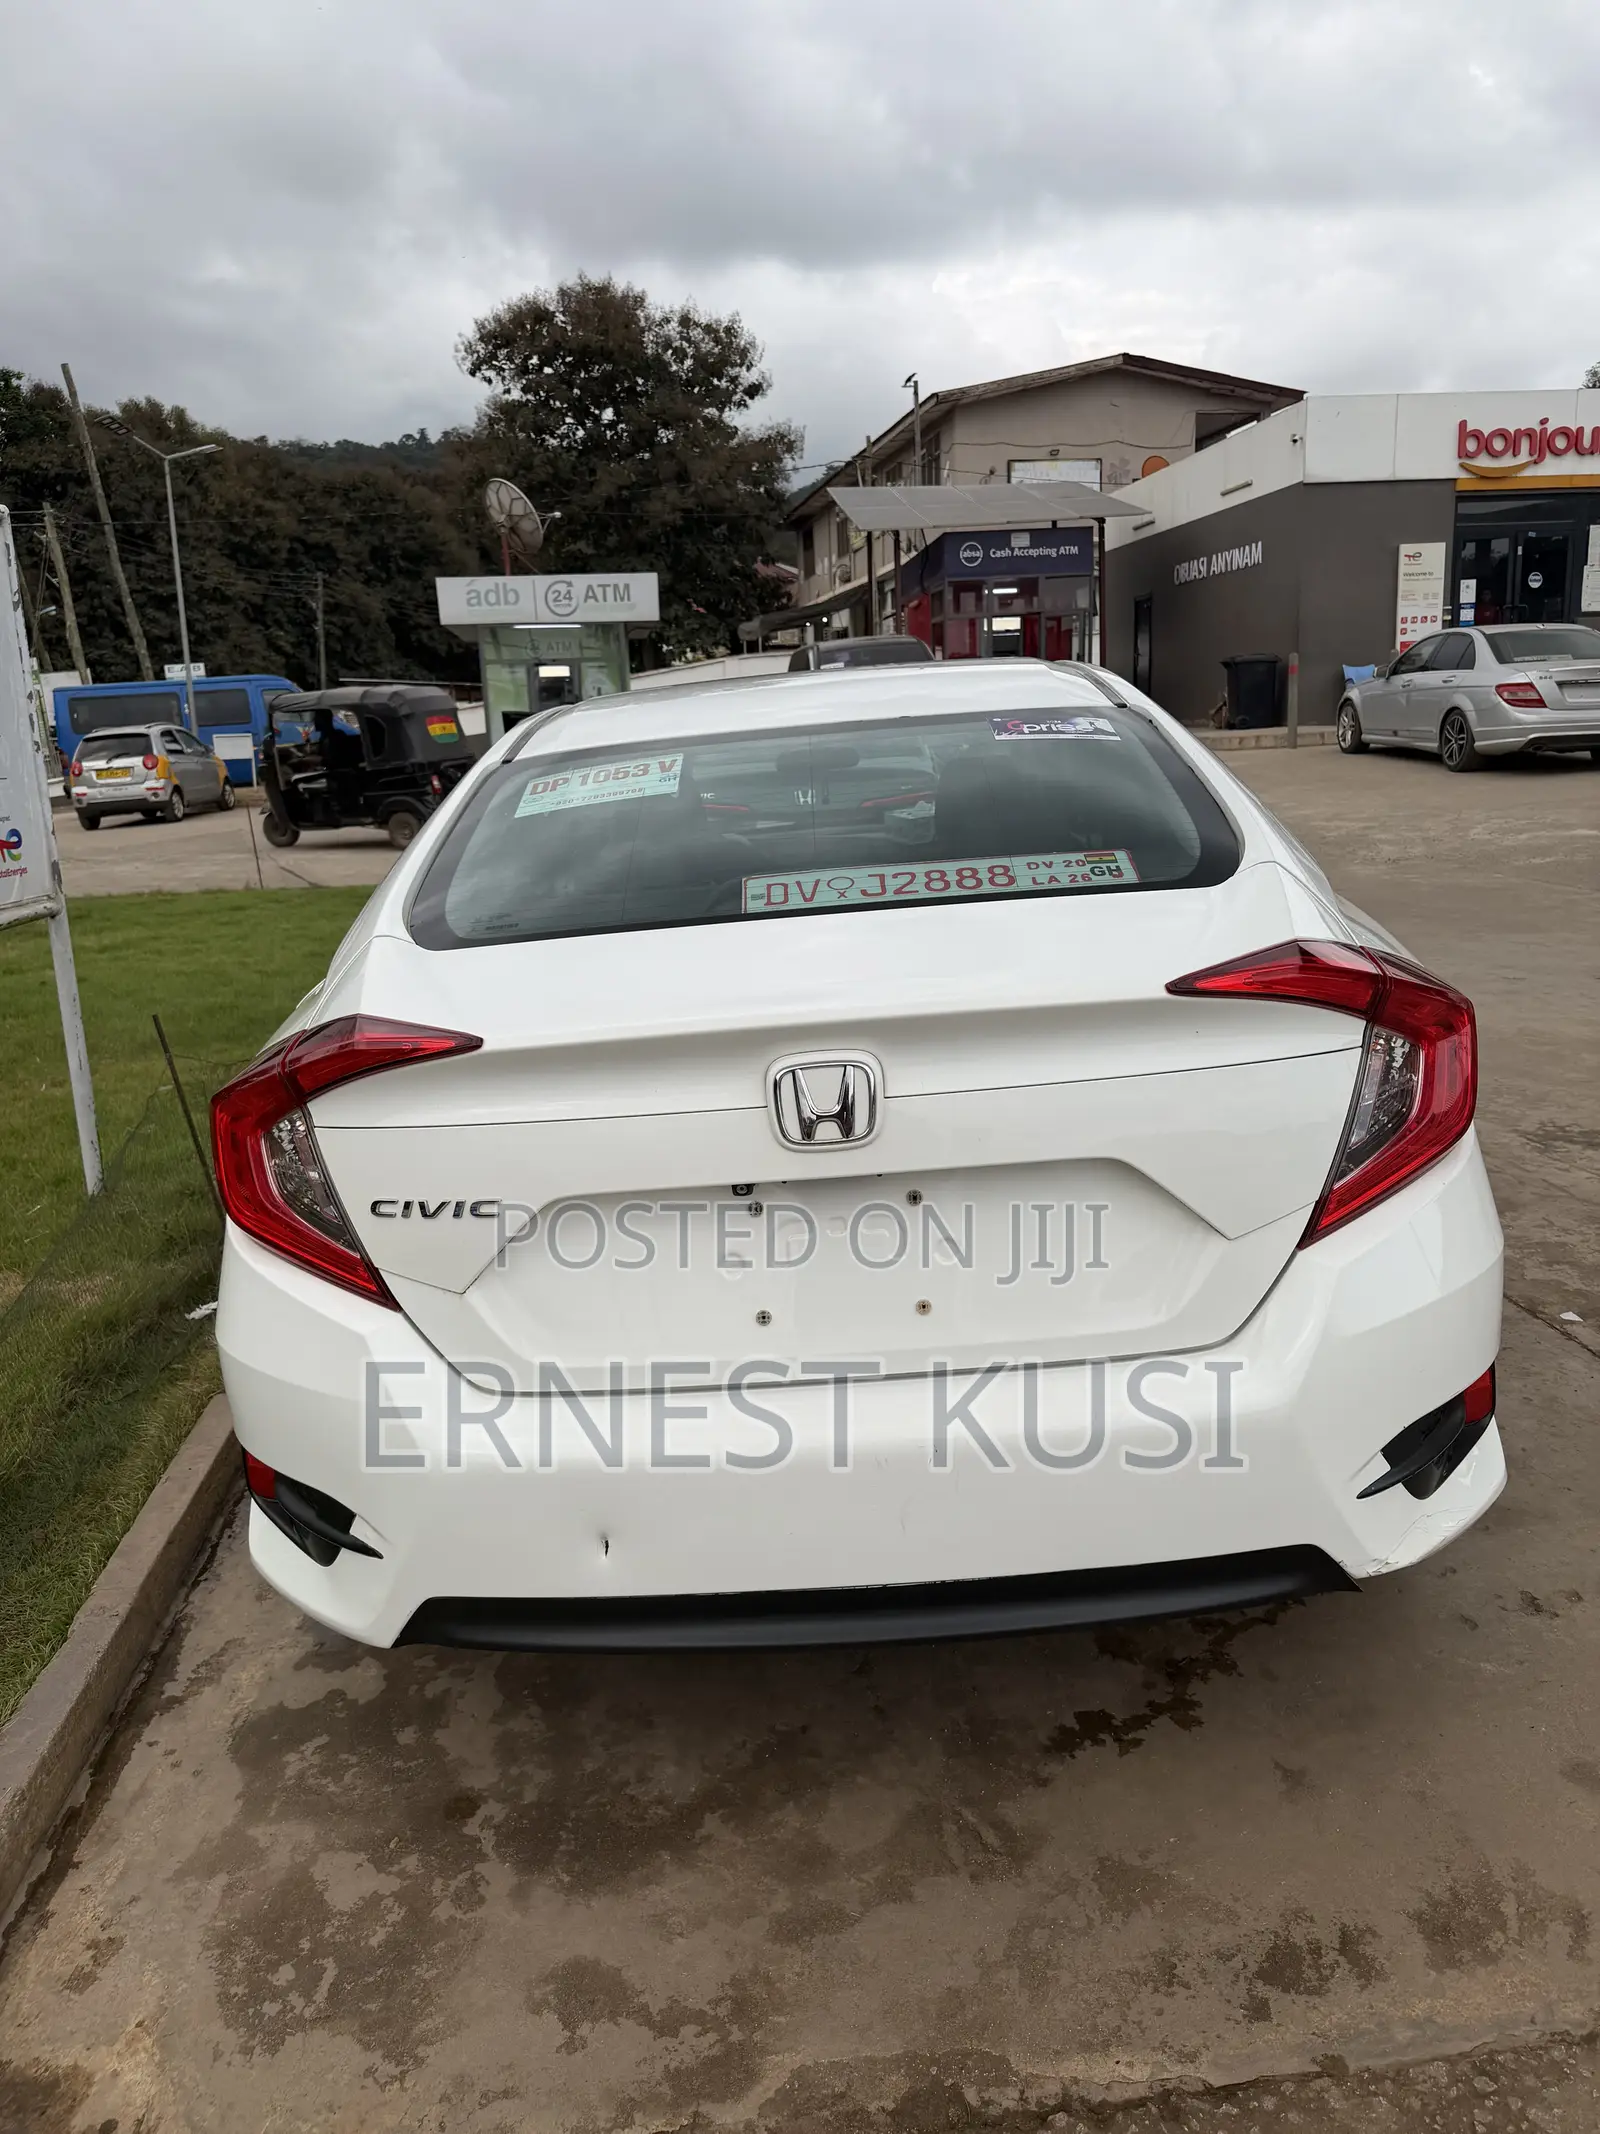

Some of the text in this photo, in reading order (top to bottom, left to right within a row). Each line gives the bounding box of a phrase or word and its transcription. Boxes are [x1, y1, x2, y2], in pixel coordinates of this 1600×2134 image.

[1457, 417, 1600, 464] bonjou
[962, 550, 981, 558] absa
[989, 546, 1079, 558] Cash Accepting ATM
[1173, 540, 1263, 586] OBUASI ANYINAM
[552, 589, 573, 603] 24
[583, 583, 632, 603] ATM
[546, 641, 572, 653] ATM
[528, 777, 570, 796] DP
[578, 763, 650, 787] 1053
[657, 758, 679, 772] V
[1026, 860, 1054, 870] DV
[1089, 865, 1122, 877] GH
[763, 864, 1016, 907] DV J2888
[1031, 874, 1061, 886] LA
[369, 1198, 501, 1219] CIVIC
